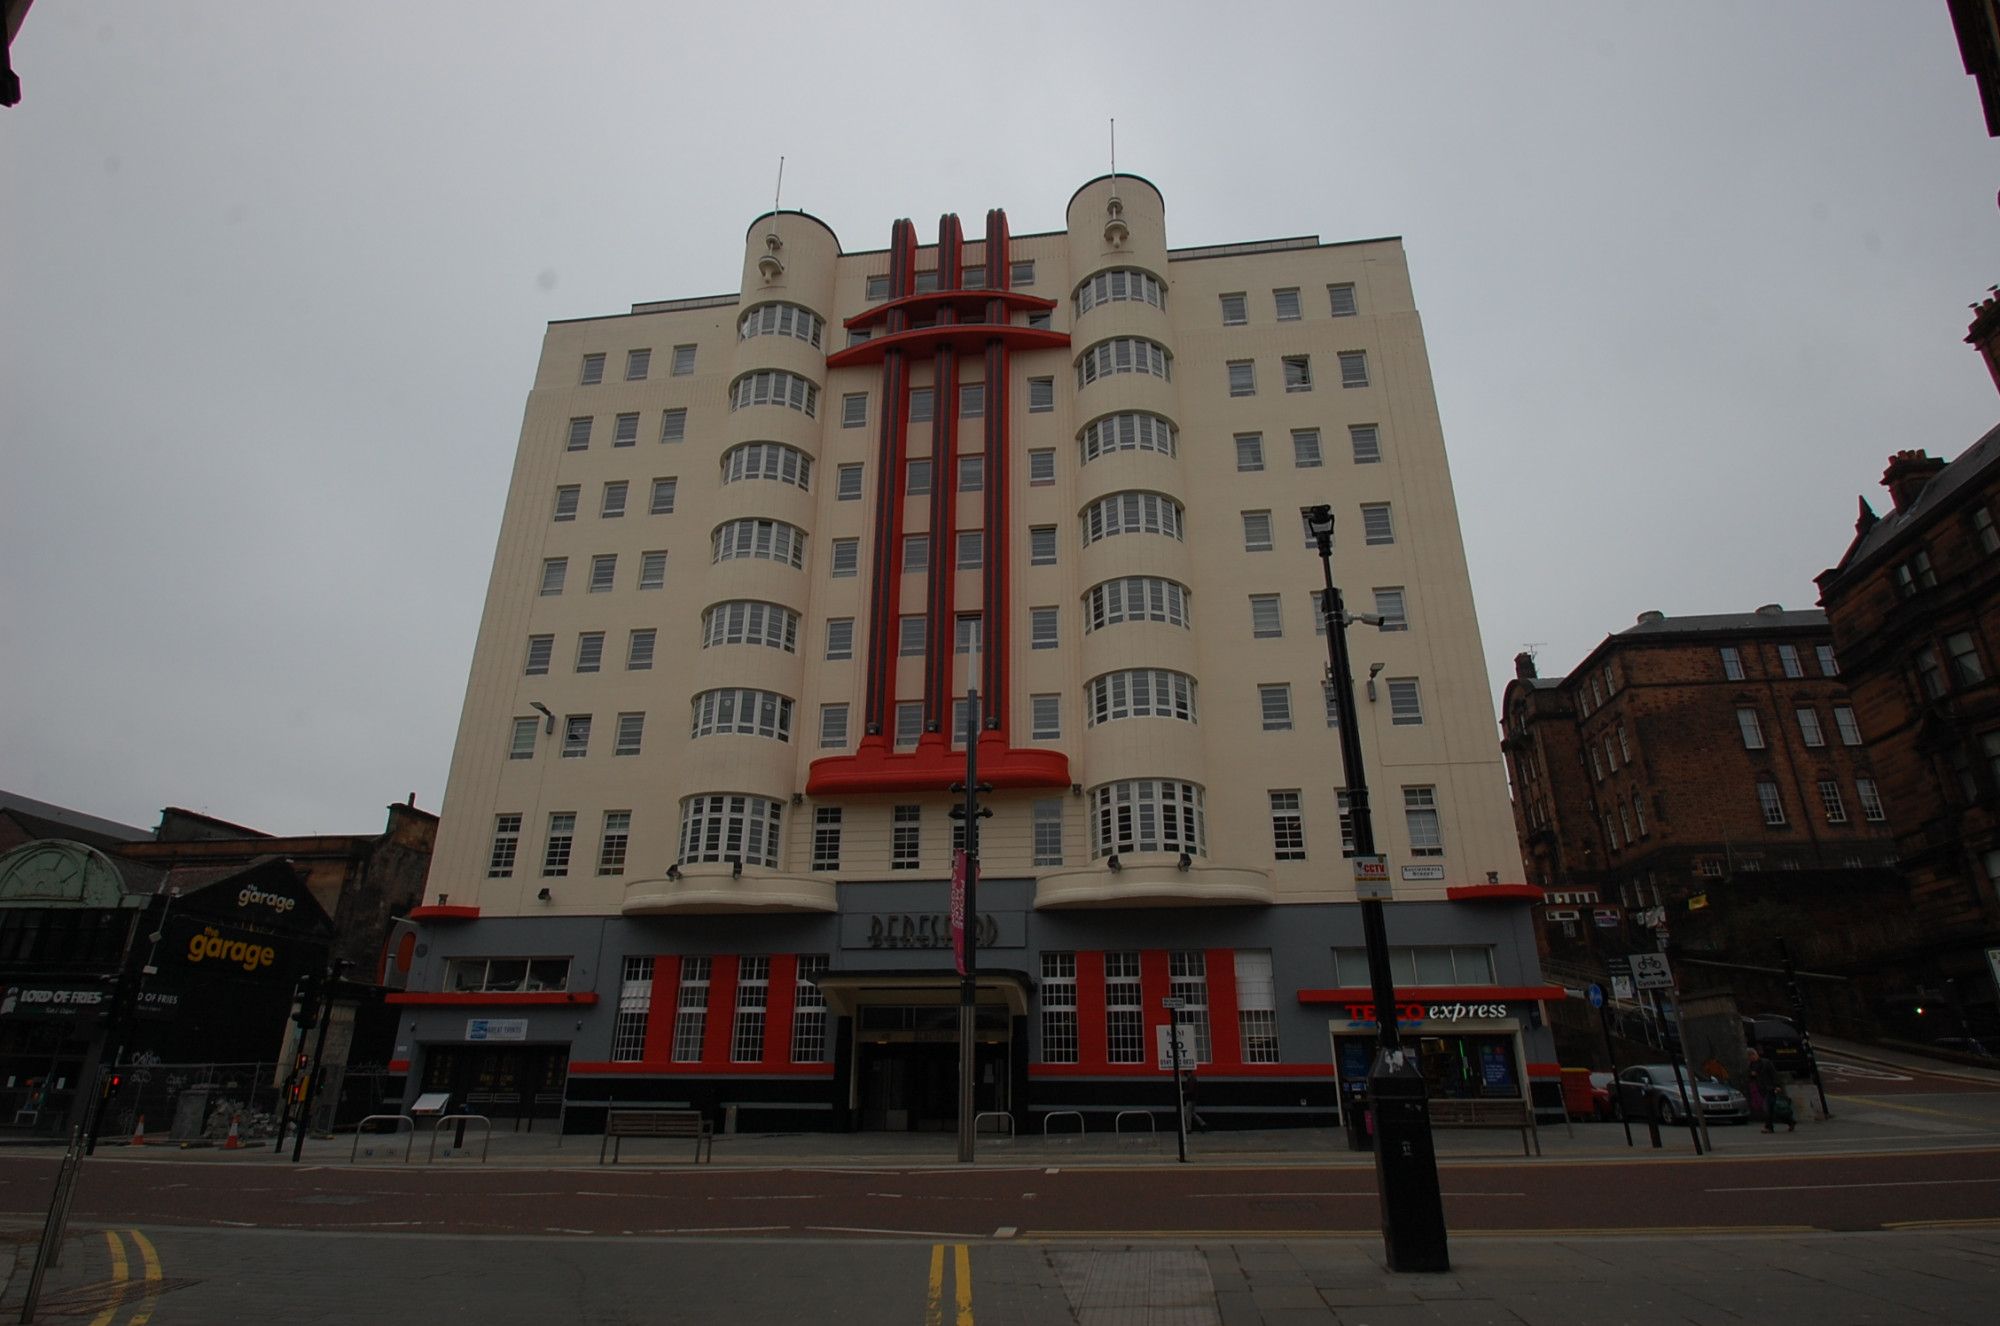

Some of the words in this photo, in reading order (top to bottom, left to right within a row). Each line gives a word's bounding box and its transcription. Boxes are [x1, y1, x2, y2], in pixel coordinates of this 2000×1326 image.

[1363, 863, 1385, 873] CCTV
[237, 889, 295, 914] garage
[186, 933, 276, 972] garage
[20, 990, 53, 1003] LORD
[53, 991, 71, 1003] OF
[71, 991, 102, 1004] FRIES
[1344, 1002, 1426, 1021] TECO
[1429, 1002, 1507, 1023] express
[1166, 1050, 1188, 1058] LT
